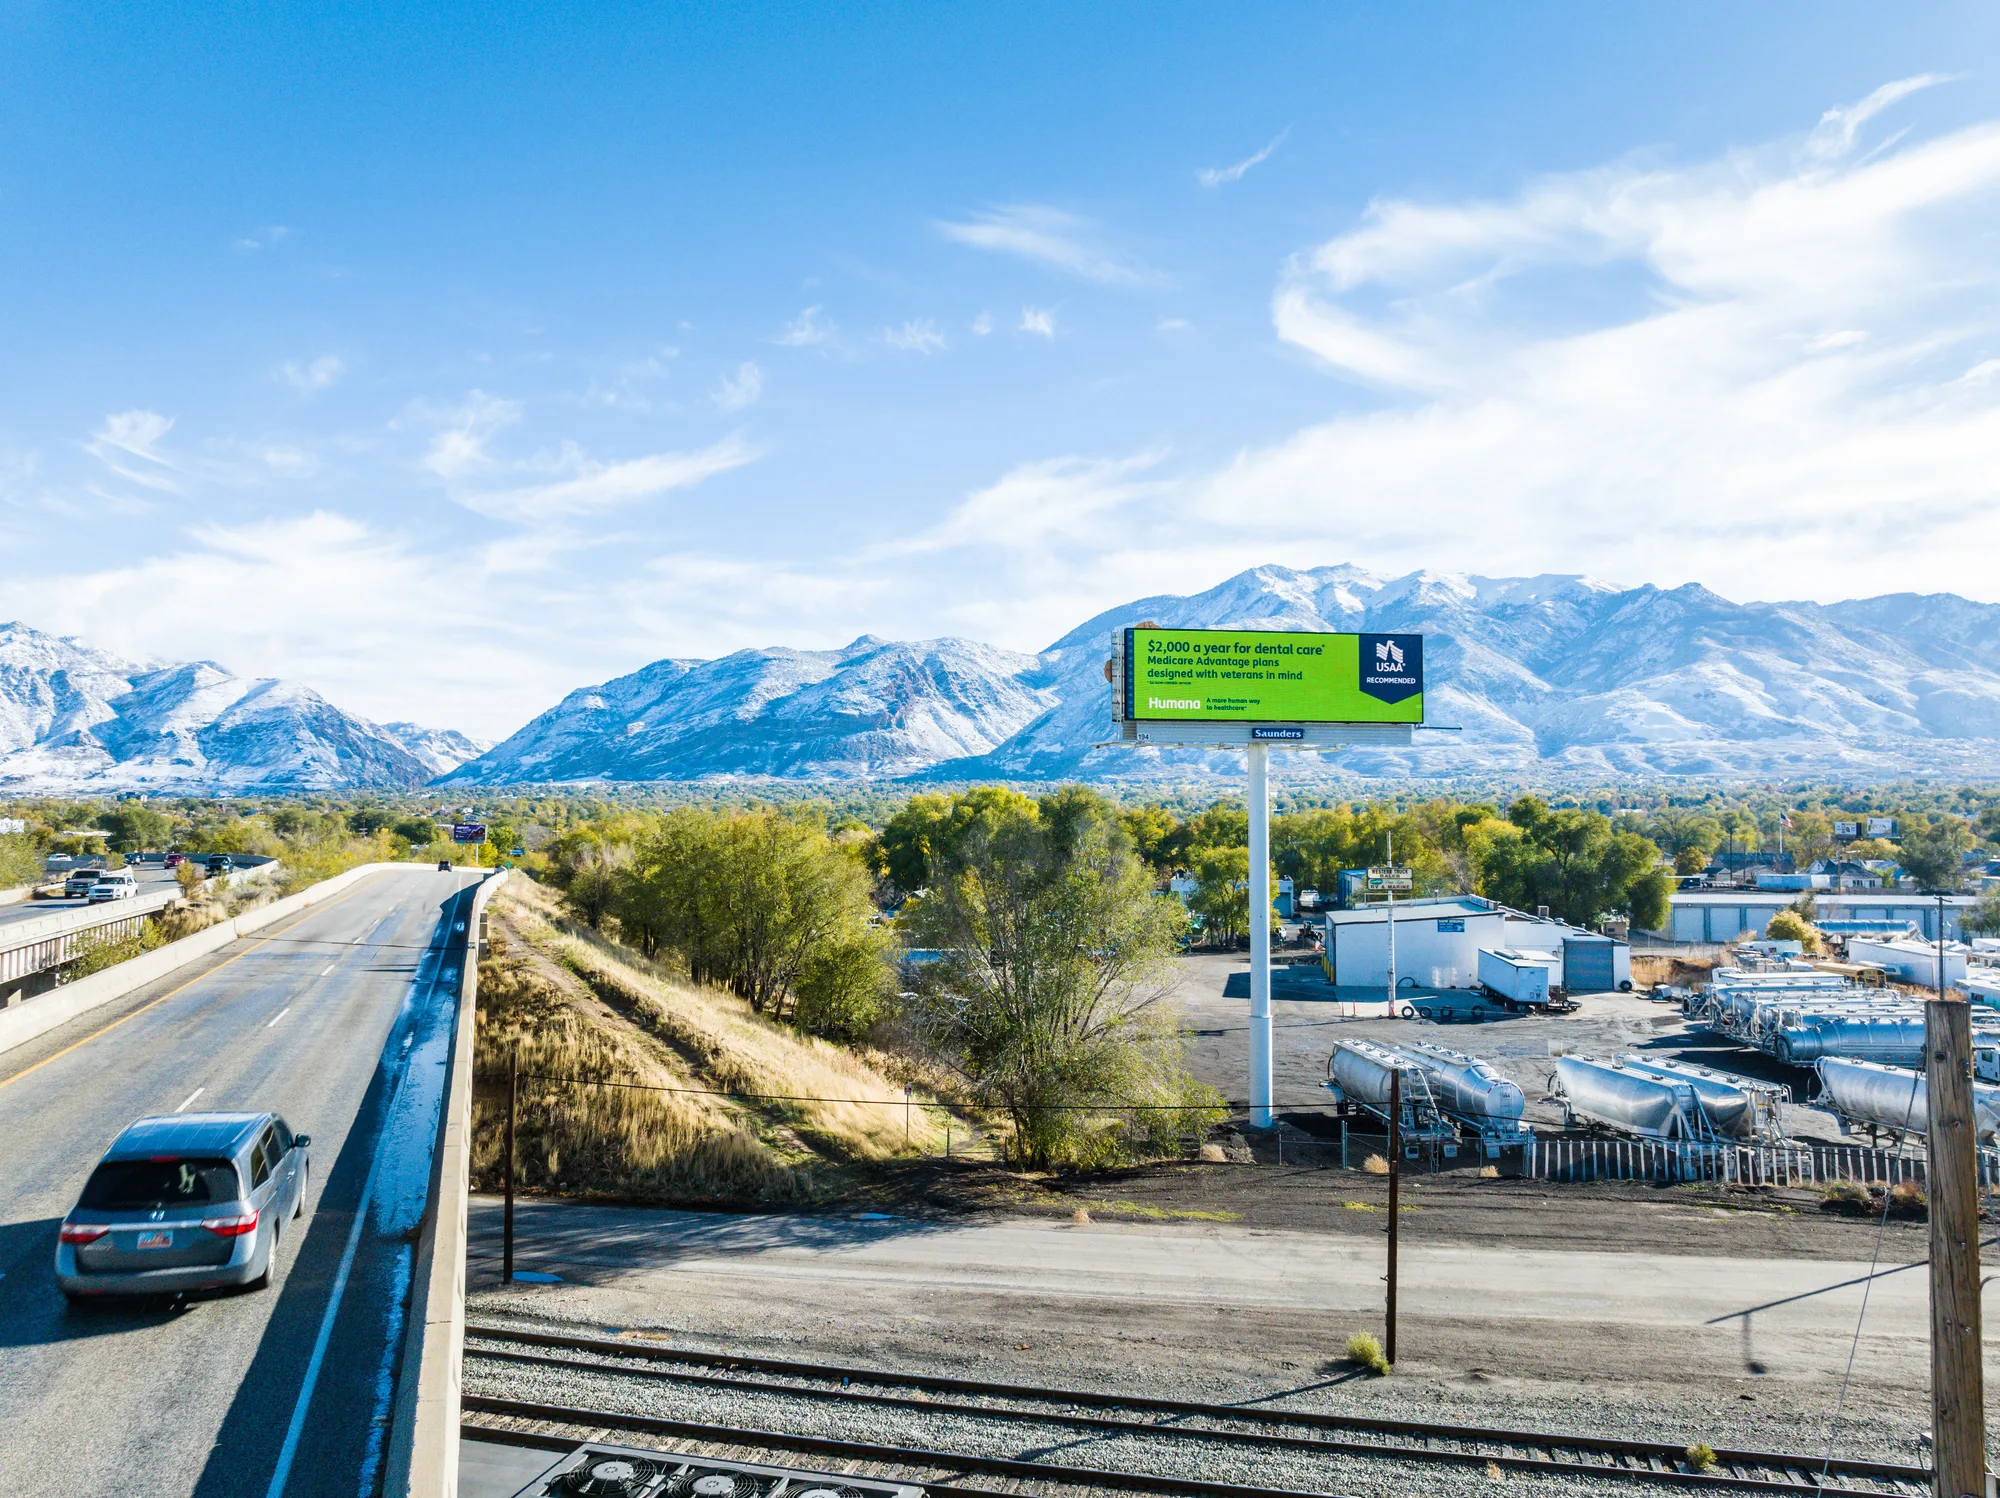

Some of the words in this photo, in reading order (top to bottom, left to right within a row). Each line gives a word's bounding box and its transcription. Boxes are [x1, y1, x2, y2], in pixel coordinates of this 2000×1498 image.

[1148, 639, 1190, 654] $2,000
[1203, 645, 1231, 656] year
[1233, 642, 1251, 654] for
[1254, 643, 1293, 655] dental
[1147, 656, 1194, 665] Medicare
[1196, 657, 1250, 668] Advantage
[1252, 658, 1280, 669] plans
[1147, 669, 1193, 680] designed
[1196, 670, 1218, 679] with
[1220, 671, 1263, 679] veterans
[1266, 671, 1275, 679] in
[1278, 671, 1303, 680] mind
[1366, 676, 1416, 684] RECOMMENDED
[1148, 697, 1201, 709] Humana
[1255, 729, 1302, 738] Saunders
